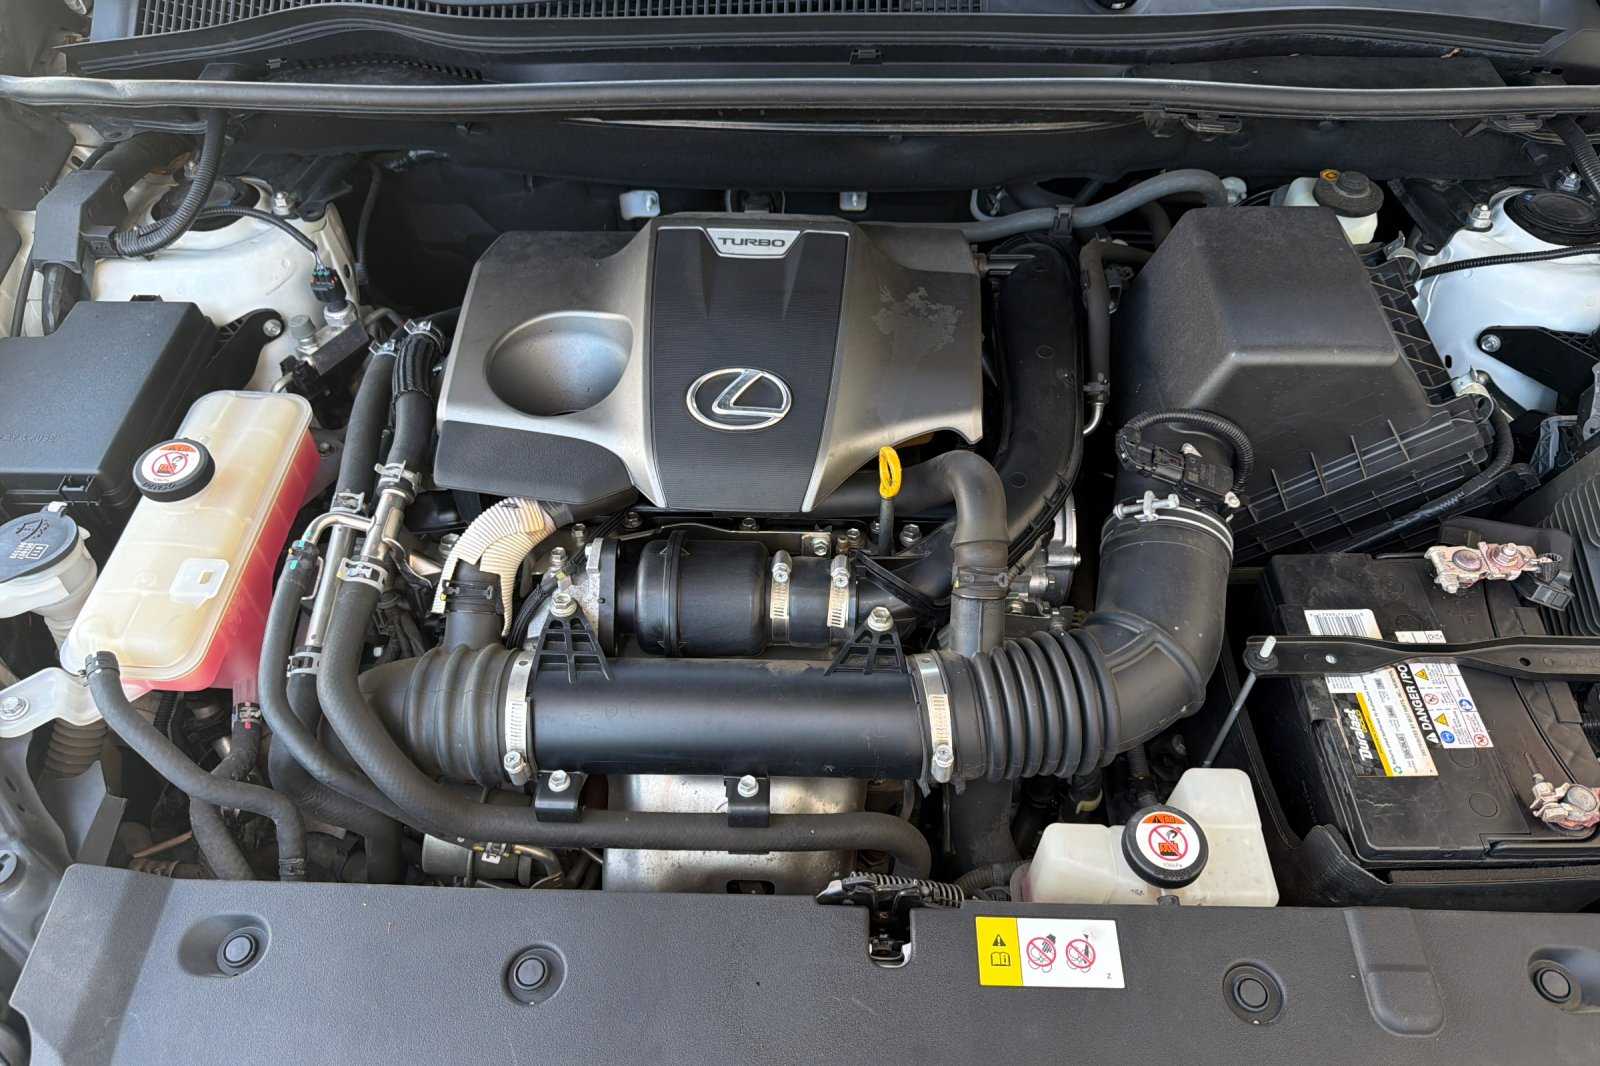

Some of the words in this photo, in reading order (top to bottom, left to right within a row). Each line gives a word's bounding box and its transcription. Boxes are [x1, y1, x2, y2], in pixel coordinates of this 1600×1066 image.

[717, 236, 786, 248] TURBO
[1406, 685, 1434, 731] DANGER
[1343, 708, 1374, 762] Duralast
